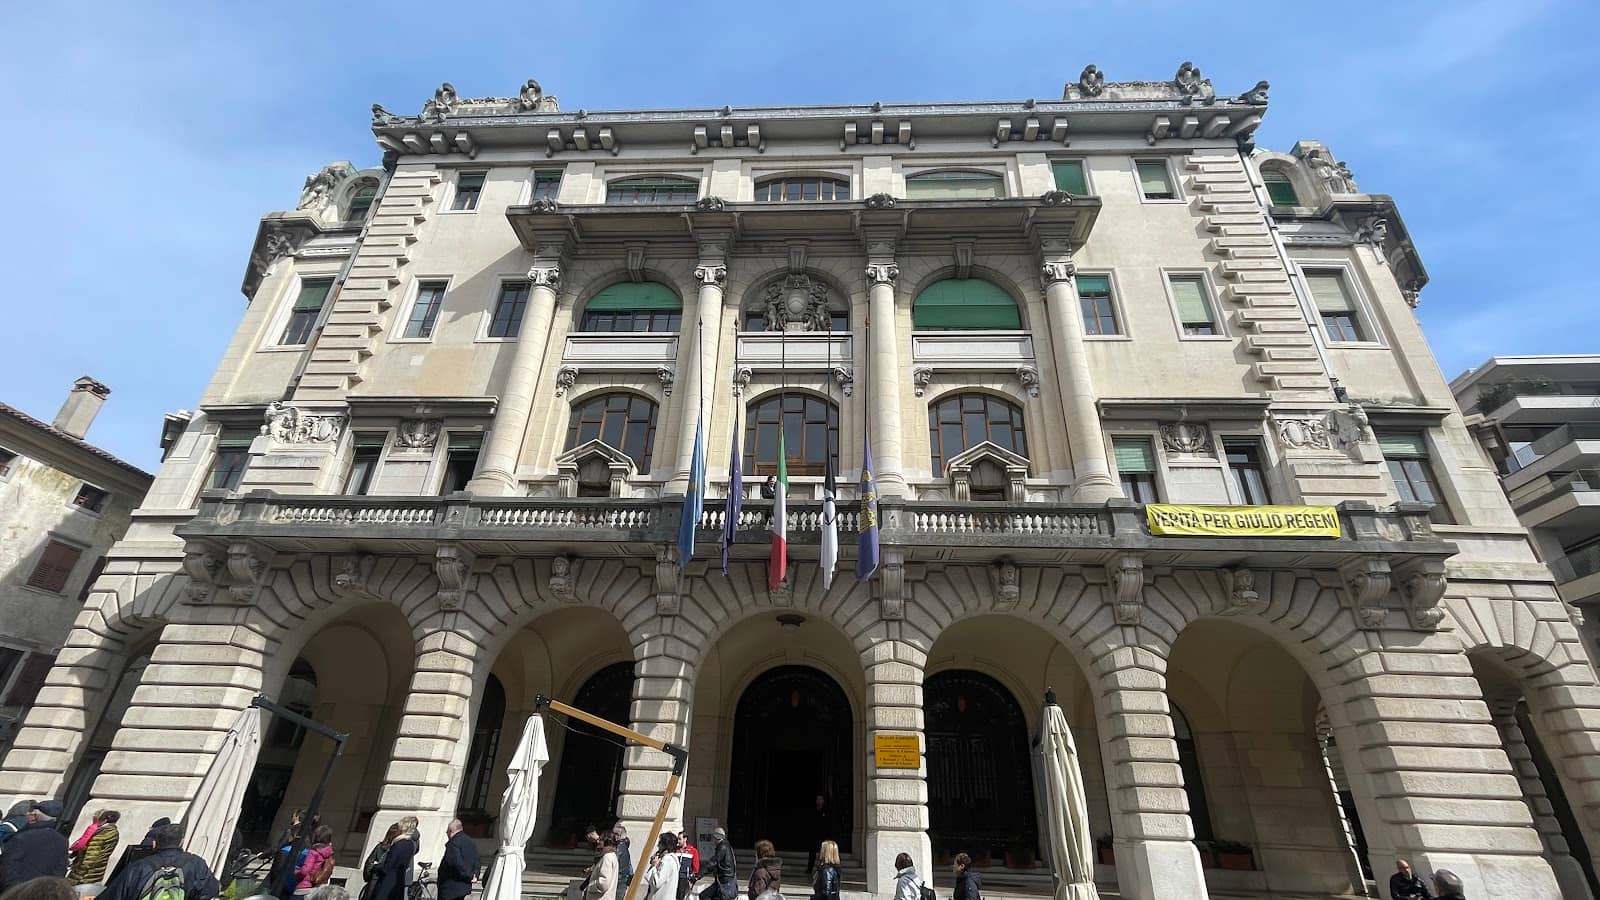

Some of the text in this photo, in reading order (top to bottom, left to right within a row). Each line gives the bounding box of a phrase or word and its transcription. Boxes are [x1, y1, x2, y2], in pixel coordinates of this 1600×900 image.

[1151, 509, 1338, 529] VERITÀ PER GIULIO REGENI
